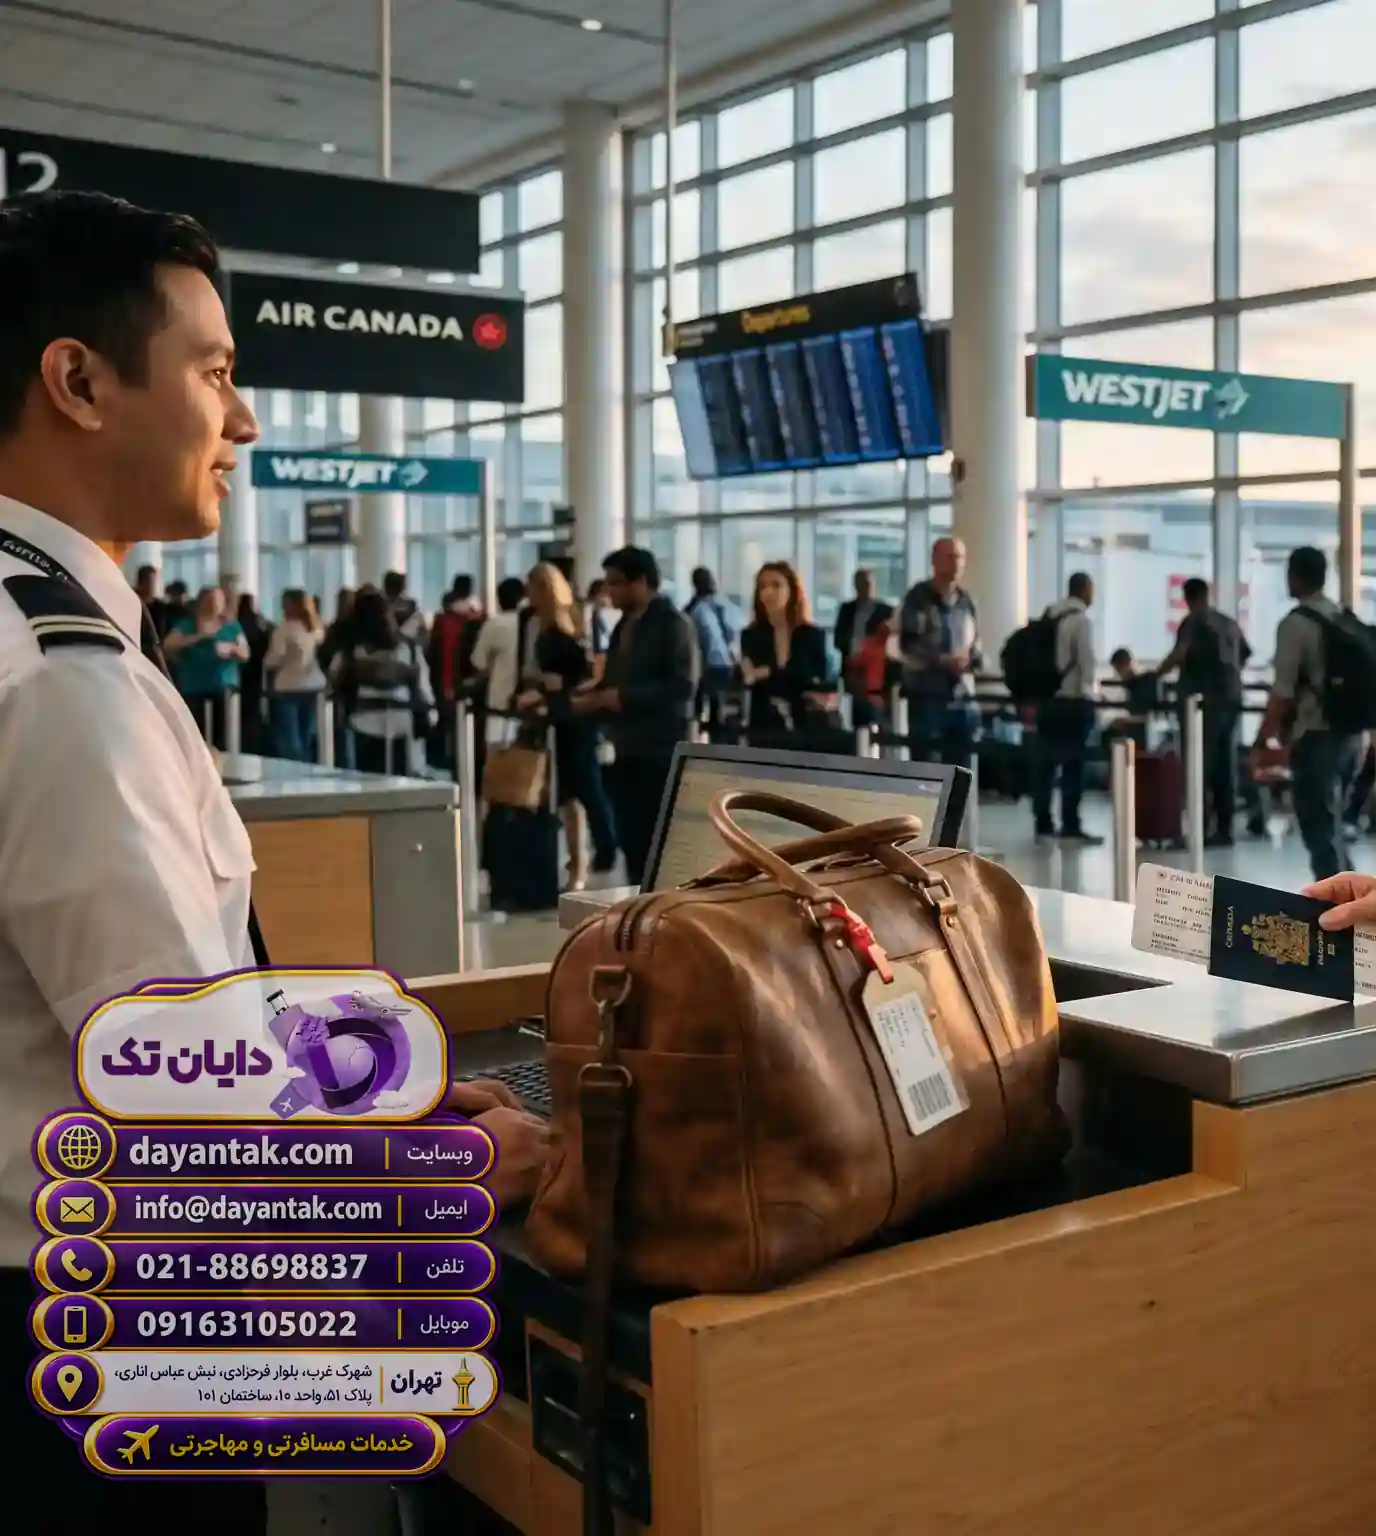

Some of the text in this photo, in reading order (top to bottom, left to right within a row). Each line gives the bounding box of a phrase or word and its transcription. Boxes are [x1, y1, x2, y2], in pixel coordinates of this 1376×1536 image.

[256, 299, 464, 341] AIR CANADA
[1061, 370, 1210, 419] WESTJET
[270, 455, 398, 489] WESTJET
